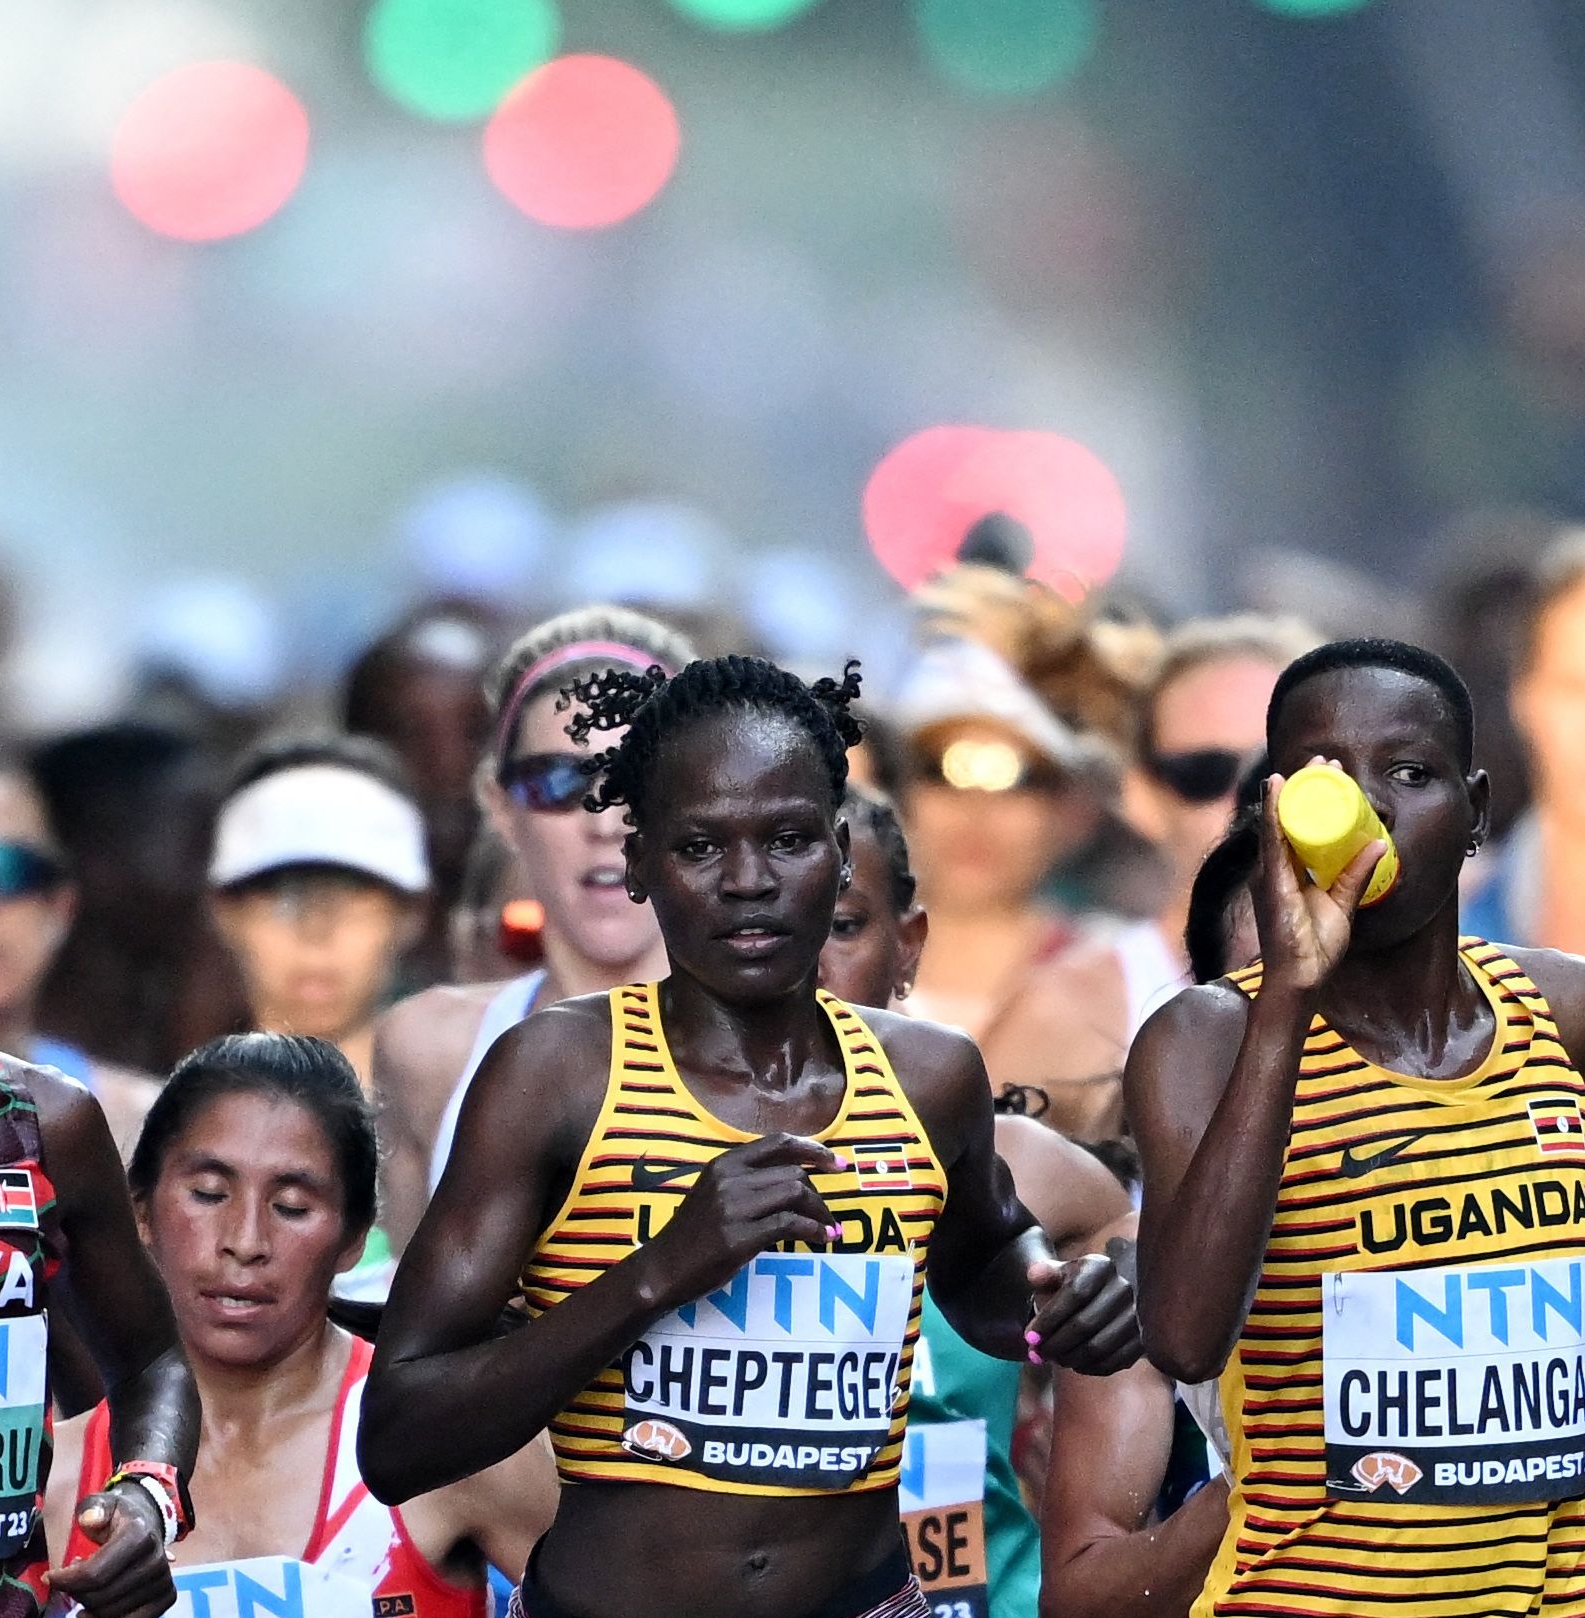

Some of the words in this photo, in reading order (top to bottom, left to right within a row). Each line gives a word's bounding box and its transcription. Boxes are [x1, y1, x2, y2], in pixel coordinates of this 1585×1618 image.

[1396, 1262, 1583, 1353] NTN
[1434, 1457, 1585, 1487] BUDAPEST
[7, 1510, 28, 1536] 23
